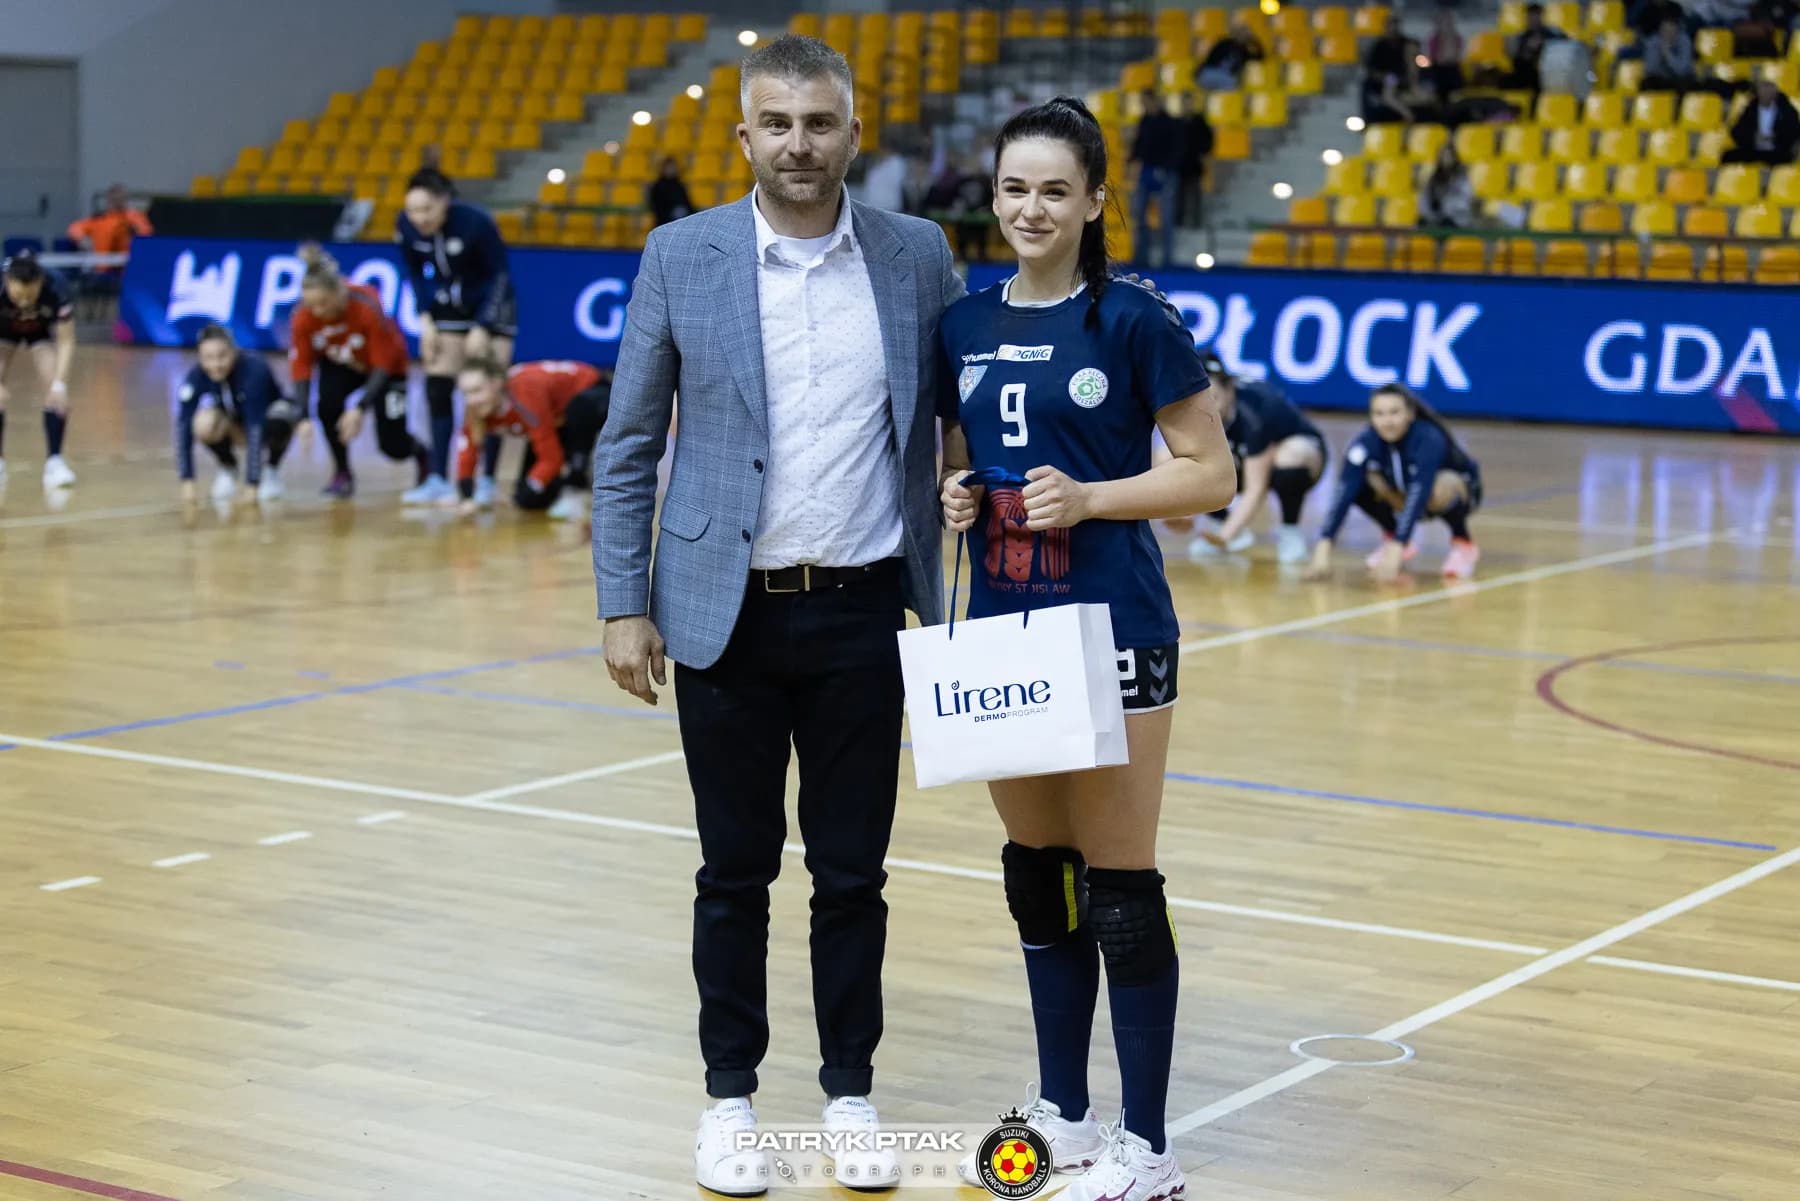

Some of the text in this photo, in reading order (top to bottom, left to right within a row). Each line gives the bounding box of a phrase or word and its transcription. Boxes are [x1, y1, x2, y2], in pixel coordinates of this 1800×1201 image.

[1584, 319, 1800, 400] GDA
[1000, 383, 1028, 447] 9
[934, 679, 1051, 717] Lirene
